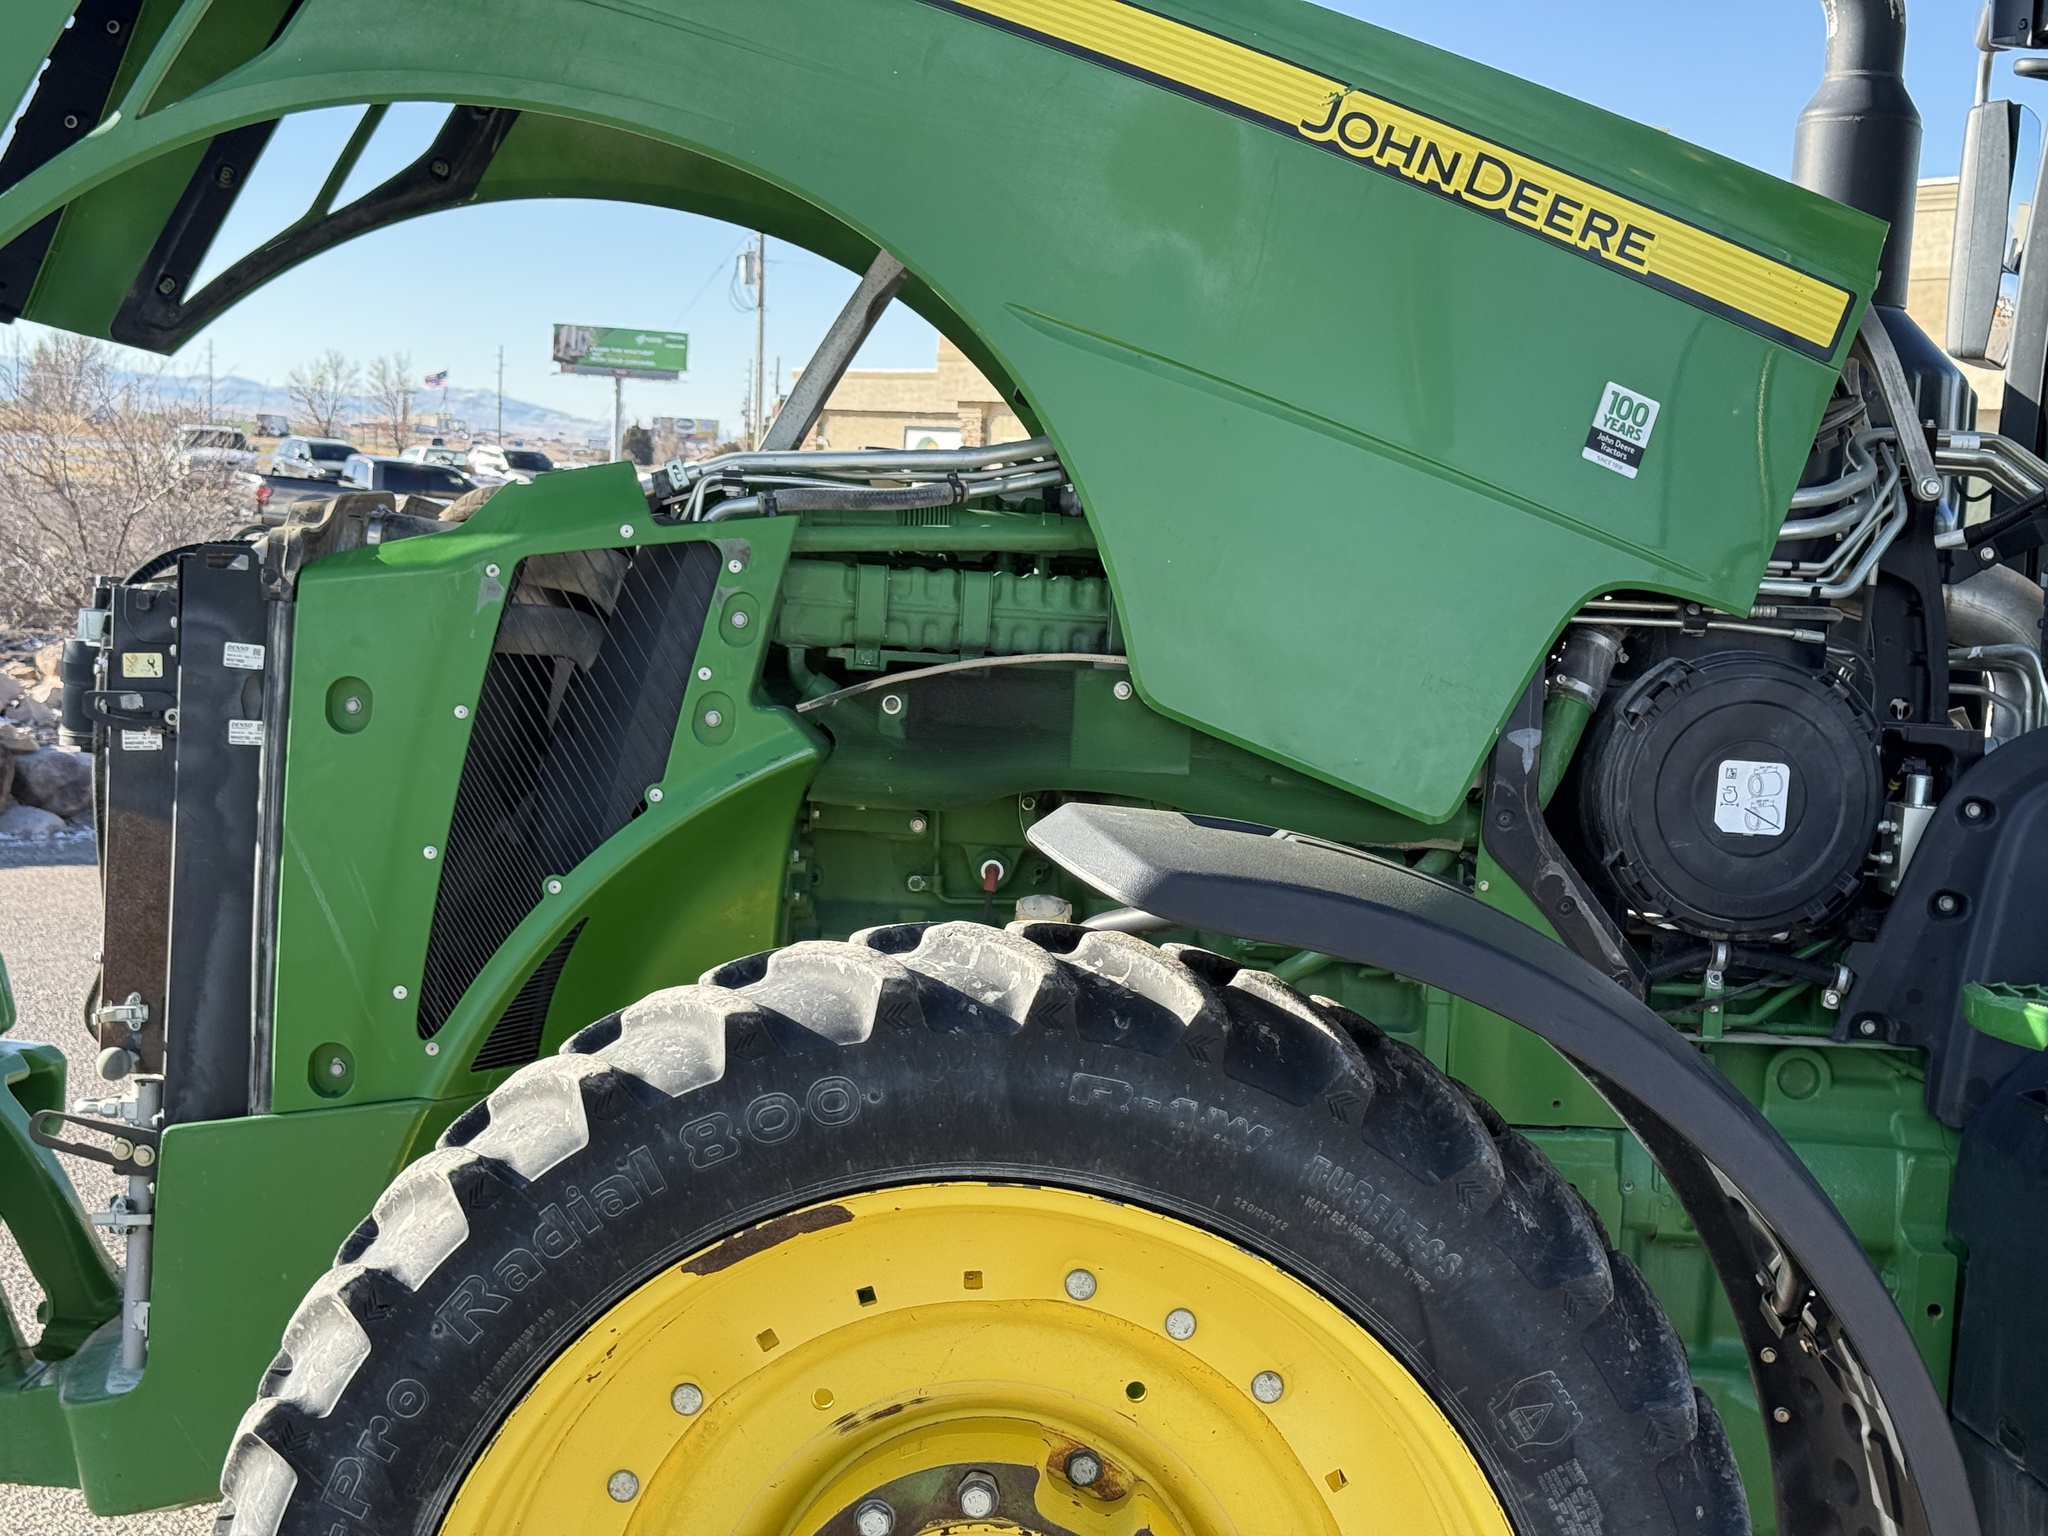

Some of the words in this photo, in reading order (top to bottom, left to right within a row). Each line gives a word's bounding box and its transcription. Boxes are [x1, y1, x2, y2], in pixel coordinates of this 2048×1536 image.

[1300, 95, 1462, 187] JOHN
[1463, 151, 1656, 267] DEERE
[1603, 413, 1643, 441] YEARS
[1607, 389, 1650, 428] 100
[1597, 432, 1615, 445] John
[1615, 438, 1636, 454] Deere
[1600, 441, 1628, 460] Tractors
[227, 644, 249, 652] DENSO
[1069, 1072, 1274, 1153] R-1W
[434, 1145, 667, 1346] Radial
[679, 1075, 861, 1170] 800
[1308, 1155, 1463, 1280] TUBELESS
